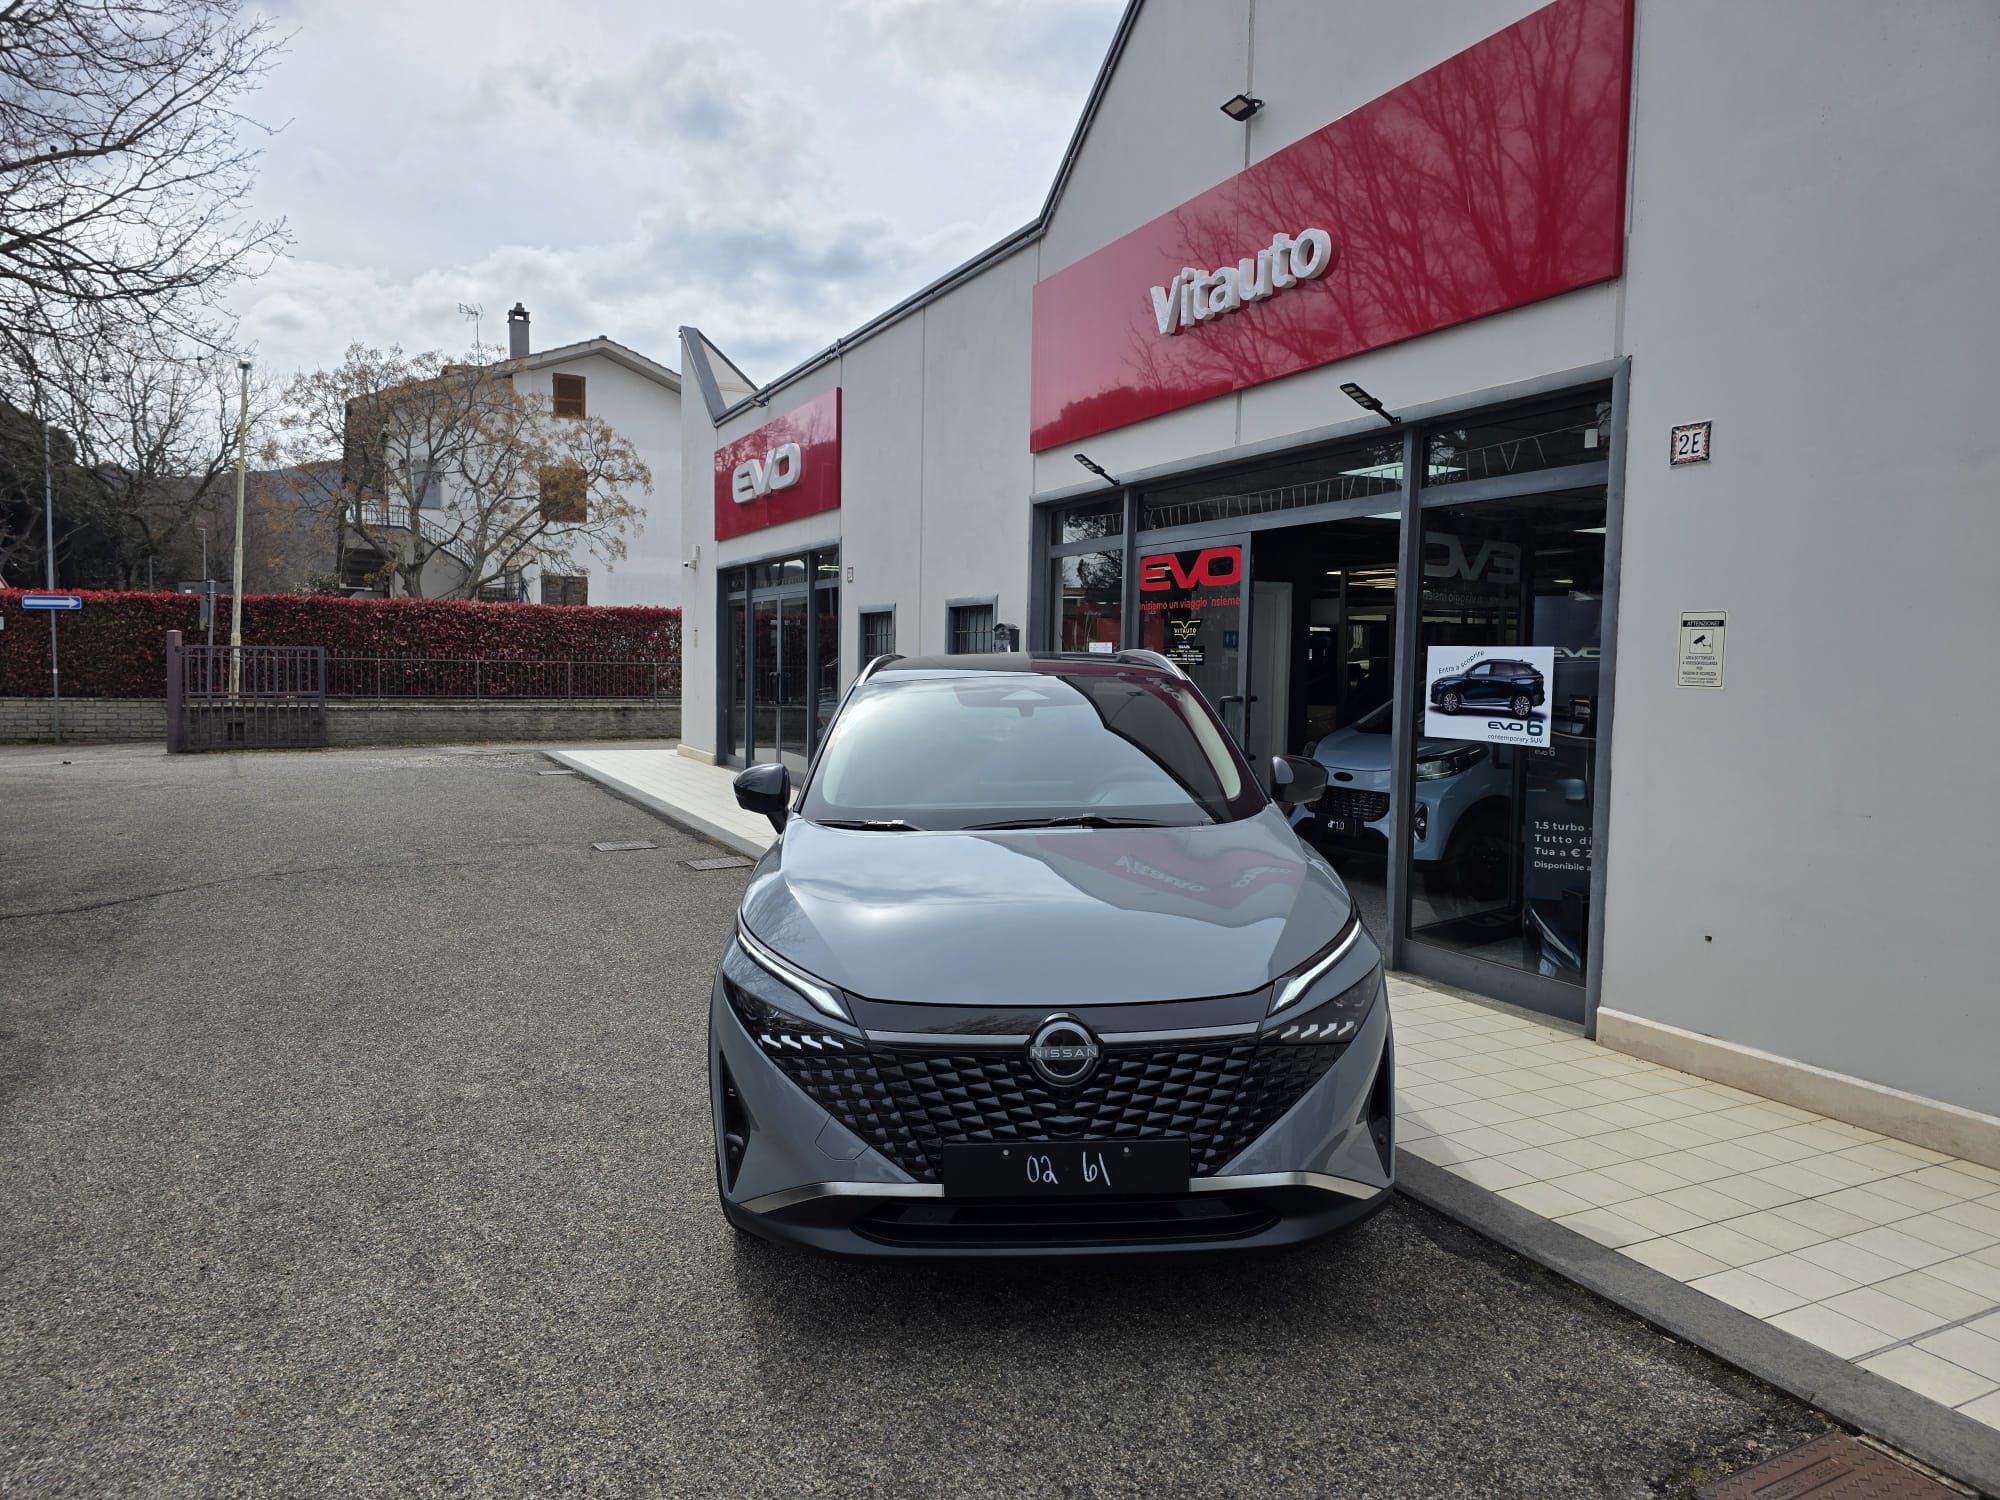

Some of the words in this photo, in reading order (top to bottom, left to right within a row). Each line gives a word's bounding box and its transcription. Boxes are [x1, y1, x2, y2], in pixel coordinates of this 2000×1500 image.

[1150, 227, 1331, 335] Vitauto
[1679, 432, 1702, 455] 2E
[732, 443, 801, 503] EVO
[1140, 546, 1242, 592] EVO
[1169, 601, 1179, 609] un
[1180, 597, 1207, 610] viaggio
[1209, 596, 1241, 607] nsieme
[1438, 665, 1455, 675] Entra
[1487, 721, 1524, 732] EVO
[1526, 718, 1544, 737] 6
[1487, 734, 1528, 744] contemporary
[1529, 736, 1544, 744] SUV
[1534, 821, 1550, 830] 1.5
[1553, 823, 1585, 832] turbo
[1534, 834, 1573, 844] Tutto
[1534, 847, 1555, 856] Tua
[1570, 848, 1581, 858] €
[1534, 860, 1585, 871] Disponibile
[1031, 1047, 1097, 1058] NISSAN
[1026, 1155, 1059, 1185] 02
